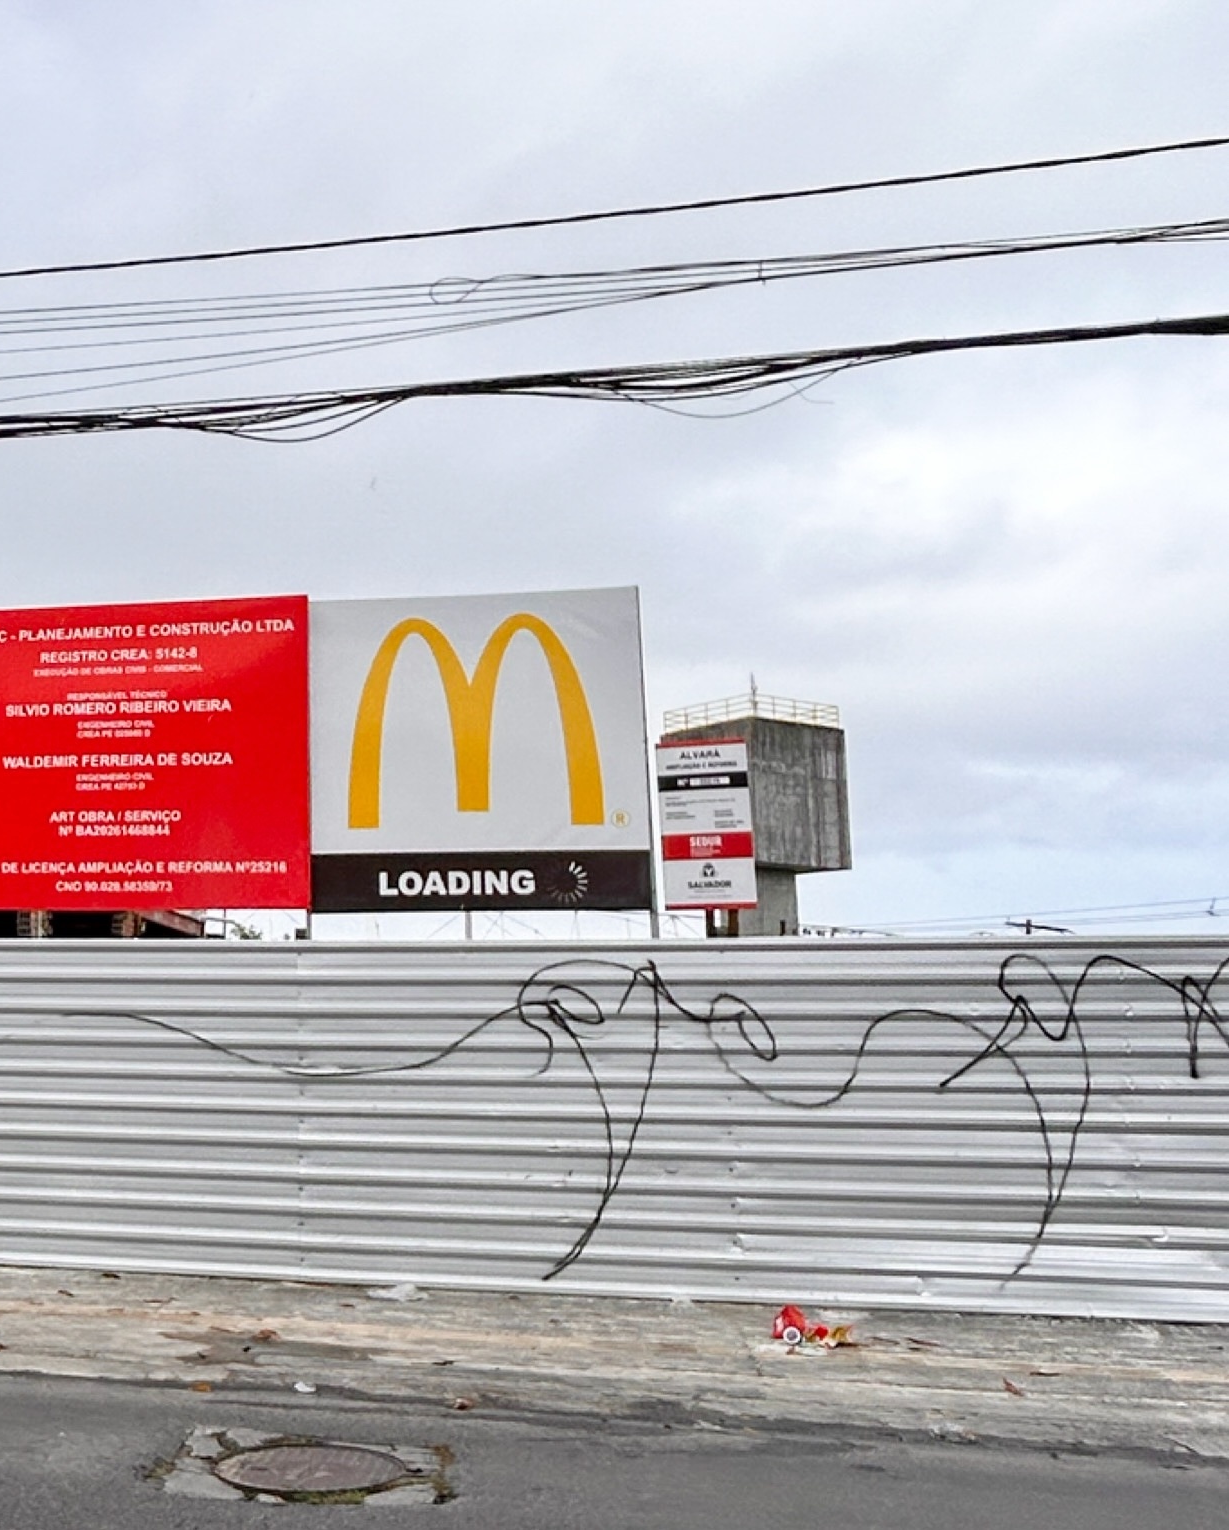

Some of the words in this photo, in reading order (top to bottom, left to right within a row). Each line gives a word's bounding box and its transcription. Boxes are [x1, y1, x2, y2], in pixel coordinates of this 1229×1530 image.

[19, 625, 132, 641] PLANEJAMENTO
[136, 625, 146, 637] E
[150, 619, 253, 636] CONSTRUÇÃO
[256, 619, 294, 632] LTDA
[40, 650, 107, 663] REGISTRO
[111, 649, 151, 661] CREA:
[156, 647, 197, 659] 5142-8
[153, 664, 202, 672] COMERCIAL
[130, 690, 167, 699] TÉCNICO
[6, 704, 49, 717] SILVIO
[53, 702, 116, 715] ROMERO
[120, 700, 179, 713] RIBEIRO
[183, 699, 231, 712] VIEIRA
[3, 755, 78, 769] WALDEMIR
[82, 754, 154, 767] FERREIRA
[157, 753, 177, 766] DE
[181, 752, 233, 765] SOUZA
[680, 750, 720, 759] ALVARÁ
[50, 811, 75, 822] ART
[78, 811, 114, 822] OBRA
[124, 810, 181, 823] SERVIÇO
[690, 836, 721, 846] SEDUR
[1, 862, 18, 873] DE
[21, 862, 75, 875] LICENÇA
[78, 860, 153, 875] AMPLIAÇÃO
[156, 862, 164, 873] E
[168, 861, 233, 873] REFORMA
[56, 881, 82, 891] CNO
[378, 869, 536, 897] LOADING
